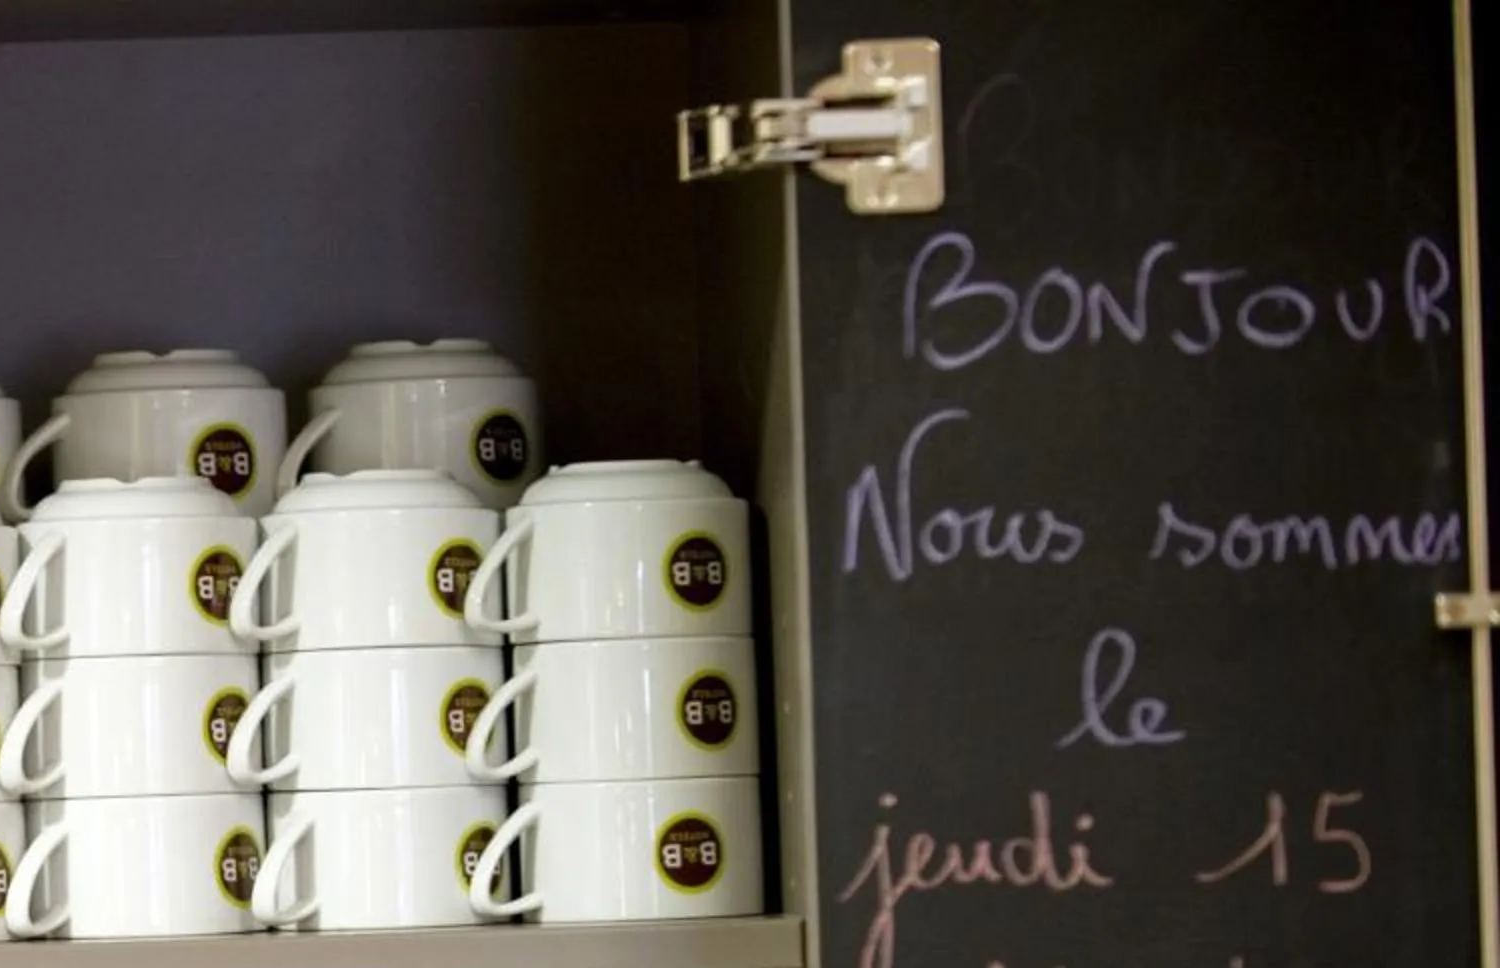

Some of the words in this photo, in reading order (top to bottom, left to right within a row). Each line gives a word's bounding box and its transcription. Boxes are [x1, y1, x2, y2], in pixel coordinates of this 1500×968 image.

[904, 231, 1450, 370] BONJOUR
[843, 409, 1084, 580] Nous
[1058, 629, 1185, 746] le
[663, 841, 716, 867] B&B
[1197, 792, 1371, 892] 15
